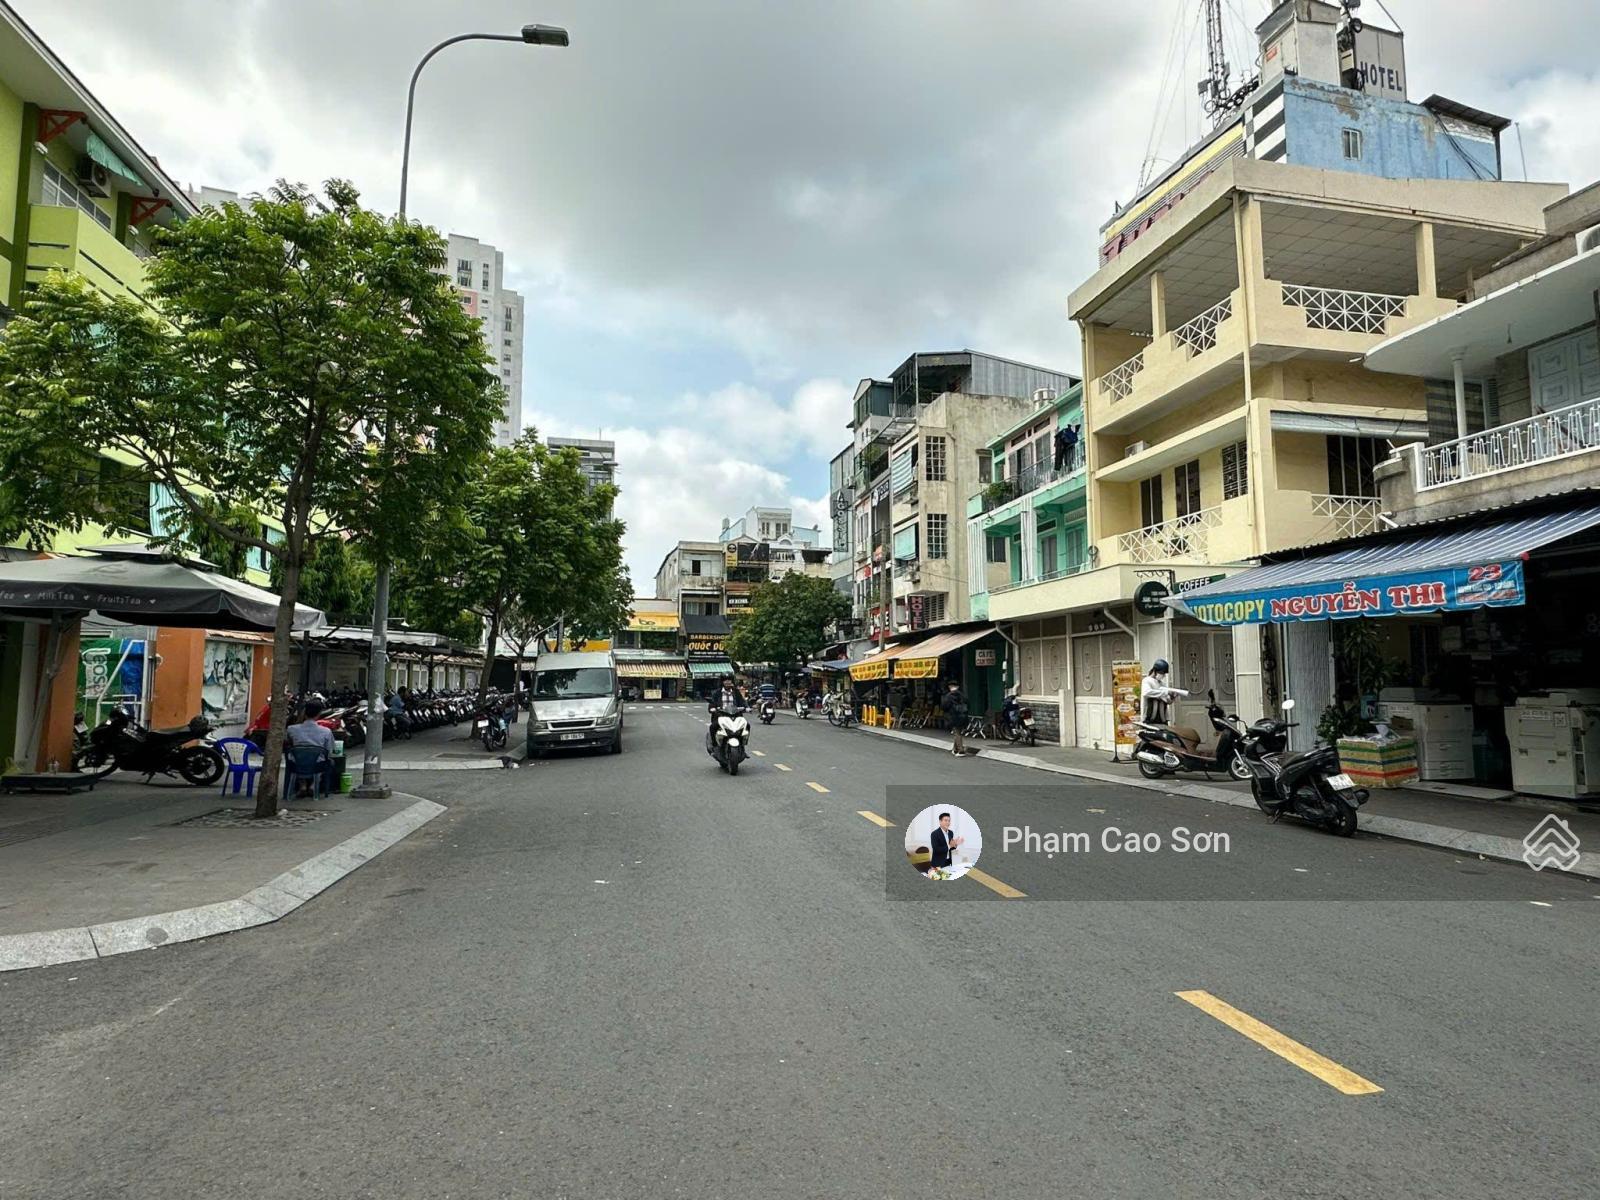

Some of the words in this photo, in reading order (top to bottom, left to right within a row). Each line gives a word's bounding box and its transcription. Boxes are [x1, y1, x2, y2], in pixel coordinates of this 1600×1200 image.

[1359, 60, 1403, 92] HOTEL
[1270, 580, 1381, 617] NGUYỄN
[1387, 582, 1447, 608] THI
